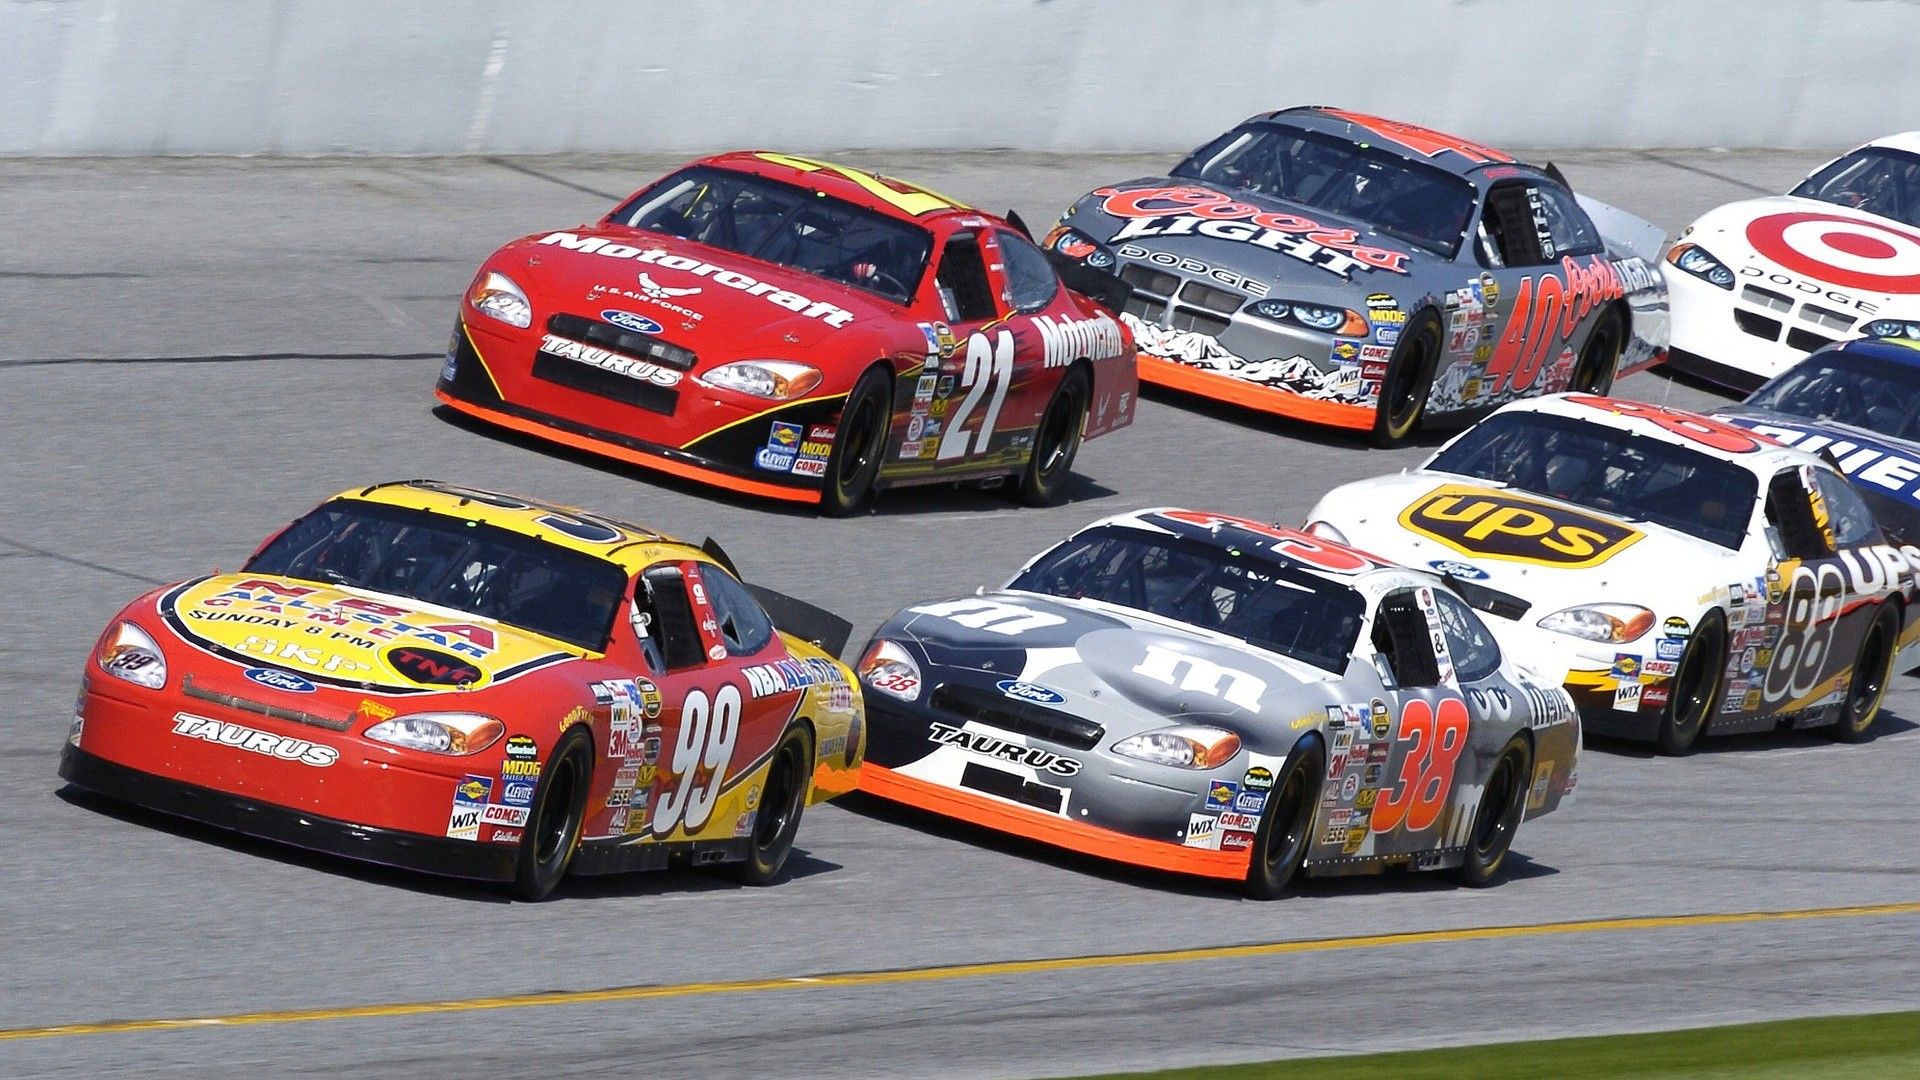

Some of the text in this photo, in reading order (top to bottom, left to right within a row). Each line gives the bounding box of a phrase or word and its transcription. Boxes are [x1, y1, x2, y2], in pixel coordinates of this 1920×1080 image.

[1093, 186, 1411, 274] Coors
[1105, 216, 1372, 278] LIGHT
[538, 232, 855, 330] Motorcraft
[1117, 245, 1270, 297] DODGE
[1740, 266, 1879, 316] DODGE
[607, 311, 656, 332] Ford
[624, 291, 651, 302] AIR
[650, 299, 704, 321] FORCE
[1368, 309, 1406, 323] MOOG
[1484, 274, 1564, 396] 40
[540, 335, 683, 387] TAURUS
[937, 330, 1015, 460] 21
[1422, 495, 1607, 556] ups
[1433, 560, 1485, 581] Ford
[188, 609, 378, 649] SUNDAY 8 PM
[204, 598, 394, 640] GAME
[233, 580, 495, 650] NBA
[1764, 564, 1846, 702] 88
[113, 652, 155, 671] 99
[251, 669, 309, 691] Ford
[741, 664, 787, 699] NBA
[873, 672, 918, 692] 38
[1002, 680, 1059, 703] Ford
[173, 713, 340, 767] TAURUS
[652, 684, 742, 834] 99
[929, 722, 1082, 776] TAURUS
[502, 759, 541, 776] MOOG
[1370, 698, 1470, 834] 38
[452, 811, 479, 829] WIX
[485, 806, 520, 821] COMP
[1190, 818, 1215, 835] WIX
[1220, 813, 1249, 826] COMP
